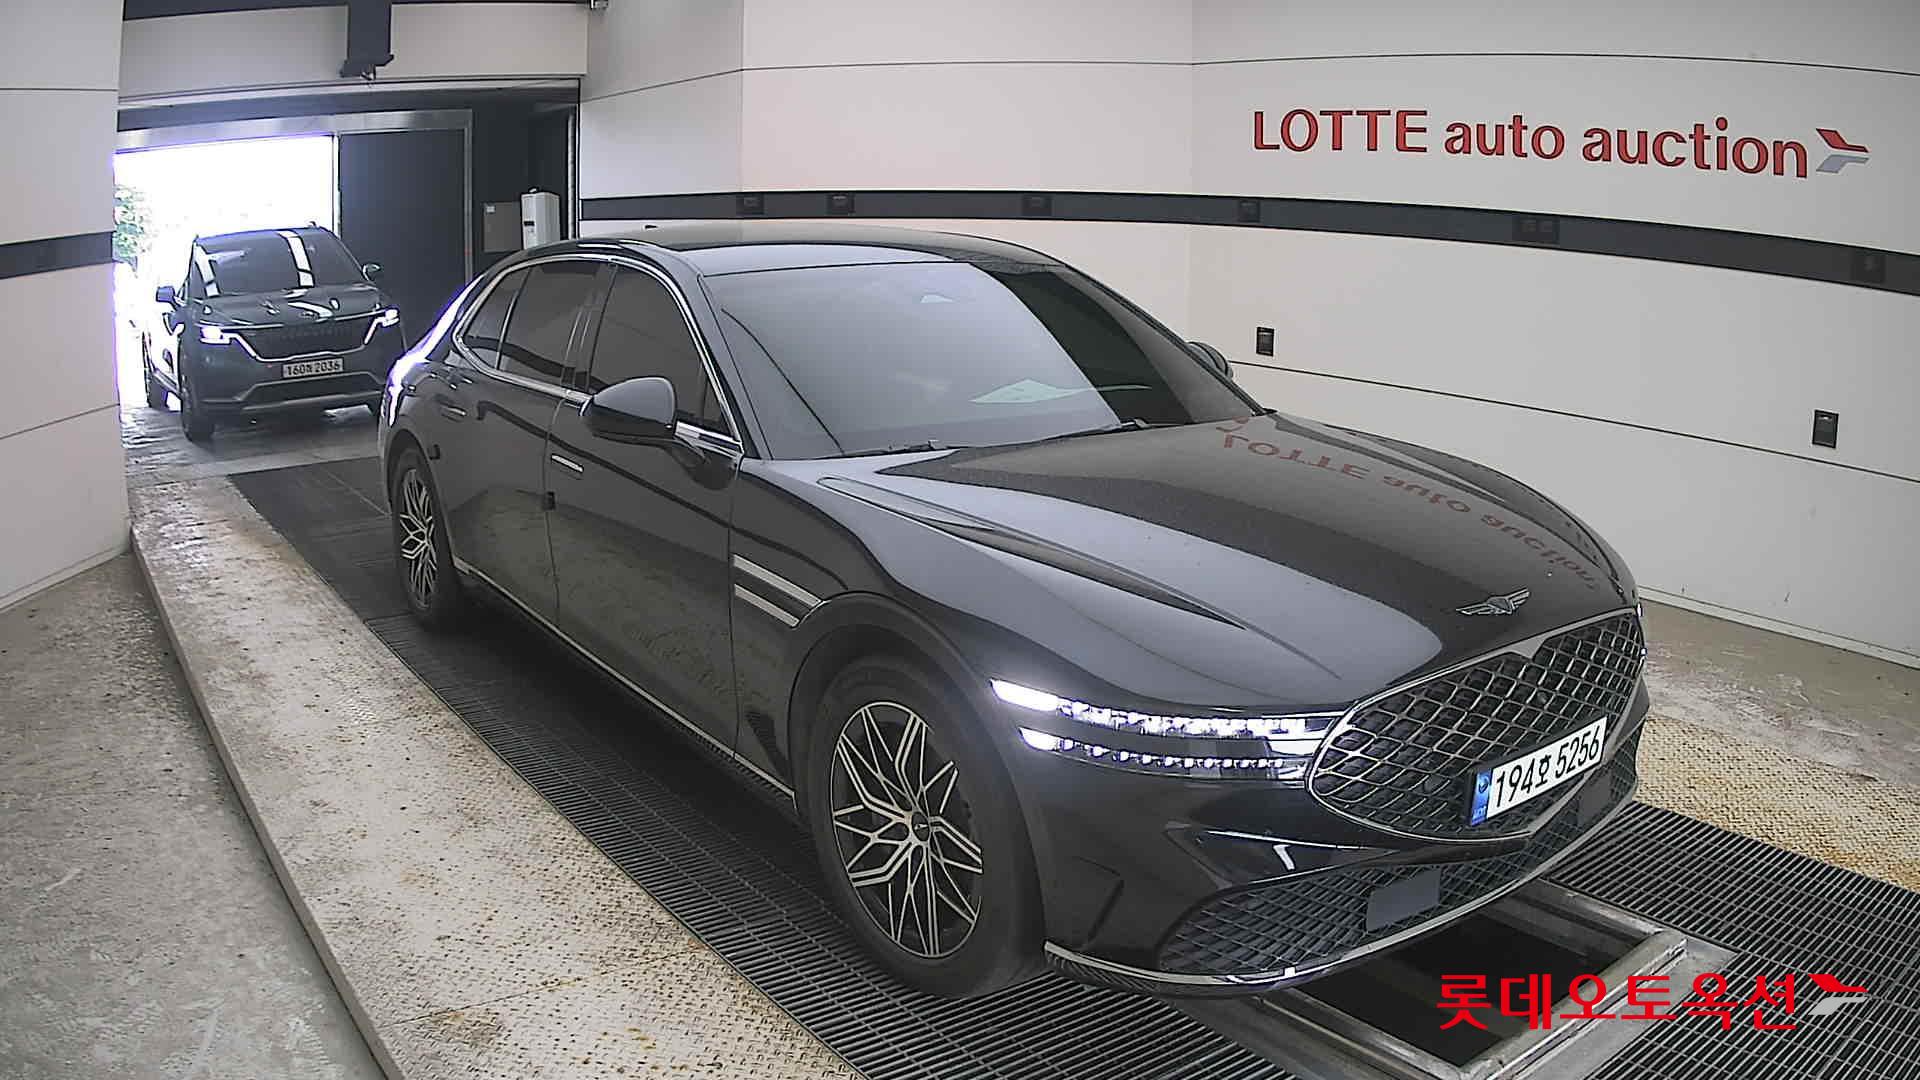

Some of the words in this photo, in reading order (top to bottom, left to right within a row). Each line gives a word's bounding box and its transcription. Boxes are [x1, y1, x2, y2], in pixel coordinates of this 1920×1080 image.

[1254, 109, 1427, 152] LOTTE
[1444, 114, 1565, 160] auto
[1582, 117, 1807, 178] auction
[1496, 754, 1551, 808] 194호
[1555, 725, 1600, 778] 5256
